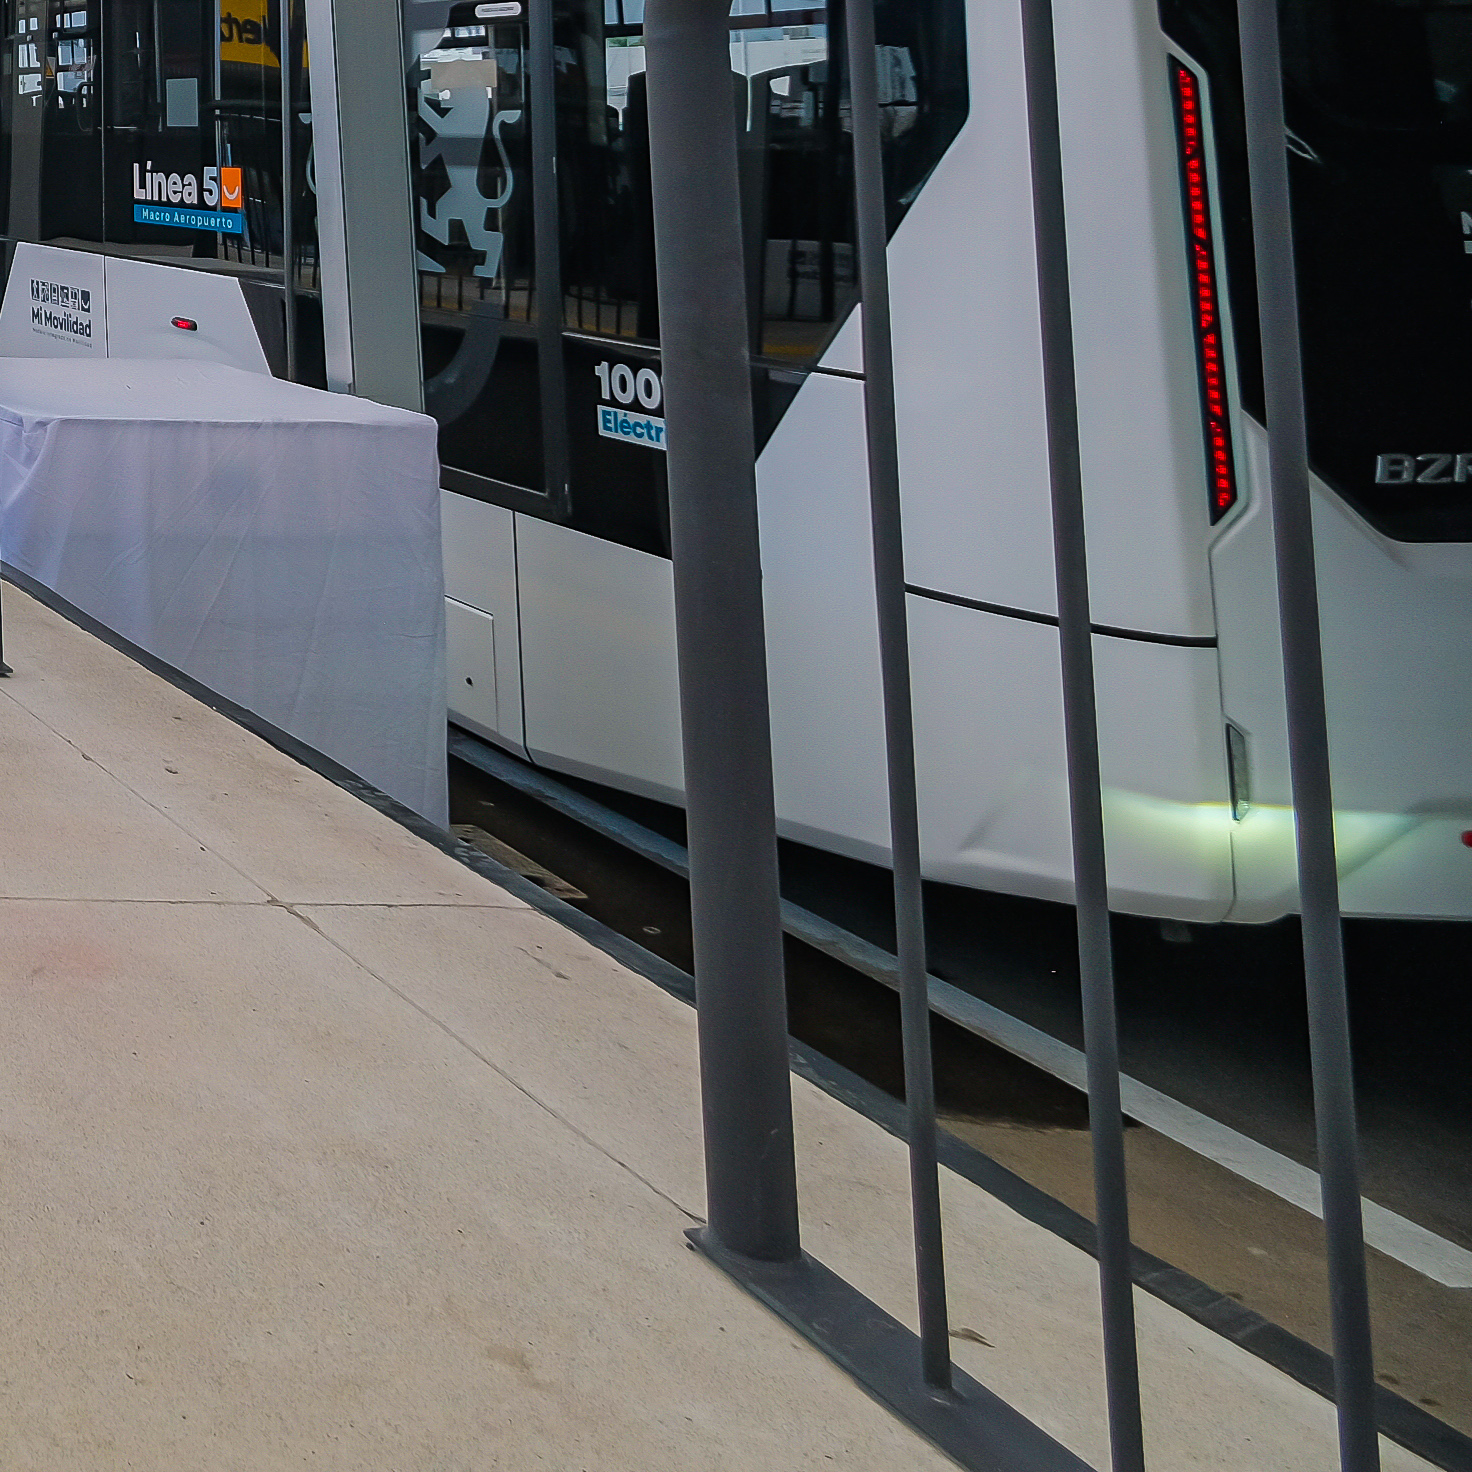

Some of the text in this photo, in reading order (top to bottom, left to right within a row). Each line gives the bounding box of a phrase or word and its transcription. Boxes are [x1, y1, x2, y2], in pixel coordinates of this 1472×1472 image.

[133, 160, 219, 206] Línea 5
[142, 208, 233, 228] Macro Aeropuerto
[32, 306, 92, 338] Mi Movilidad
